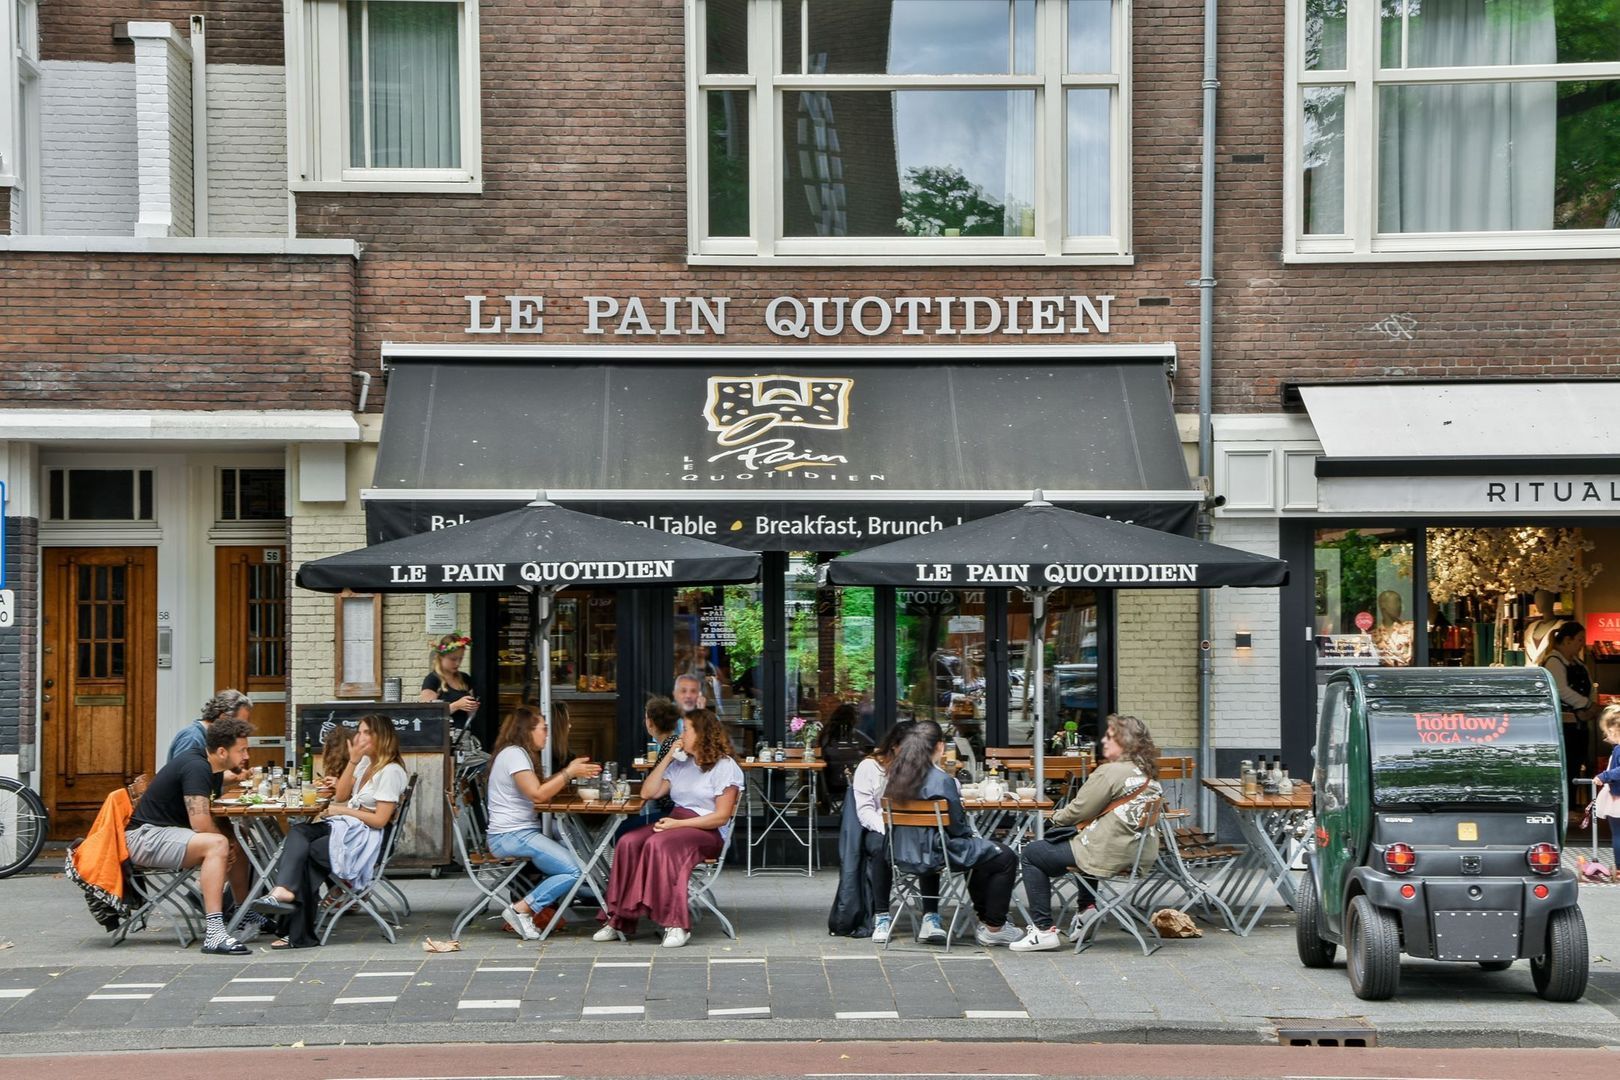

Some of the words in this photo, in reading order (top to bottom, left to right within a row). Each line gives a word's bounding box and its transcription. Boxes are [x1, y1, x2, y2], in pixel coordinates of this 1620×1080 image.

[464, 296, 544, 335] LE
[582, 296, 732, 336] PAIN
[765, 295, 1115, 339] QUOTIDIEN
[707, 439, 849, 470] Pain
[681, 470, 886, 482] QUOTIDIEN
[1487, 481, 1620, 502] RITUAL
[659, 515, 717, 536] Table
[756, 515, 862, 538] Breakfast,
[266, 551, 279, 561] 56
[390, 565, 427, 583] LE
[441, 563, 506, 583] PAIN
[520, 560, 675, 583] QUOTIDIEN
[916, 564, 951, 582] LE
[966, 564, 1030, 582] PAIN
[1044, 564, 1199, 584] QUOTIDIEN
[158, 611, 170, 620] 58
[1413, 712, 1497, 731] hotflow
[1418, 731, 1461, 744] YOGA
